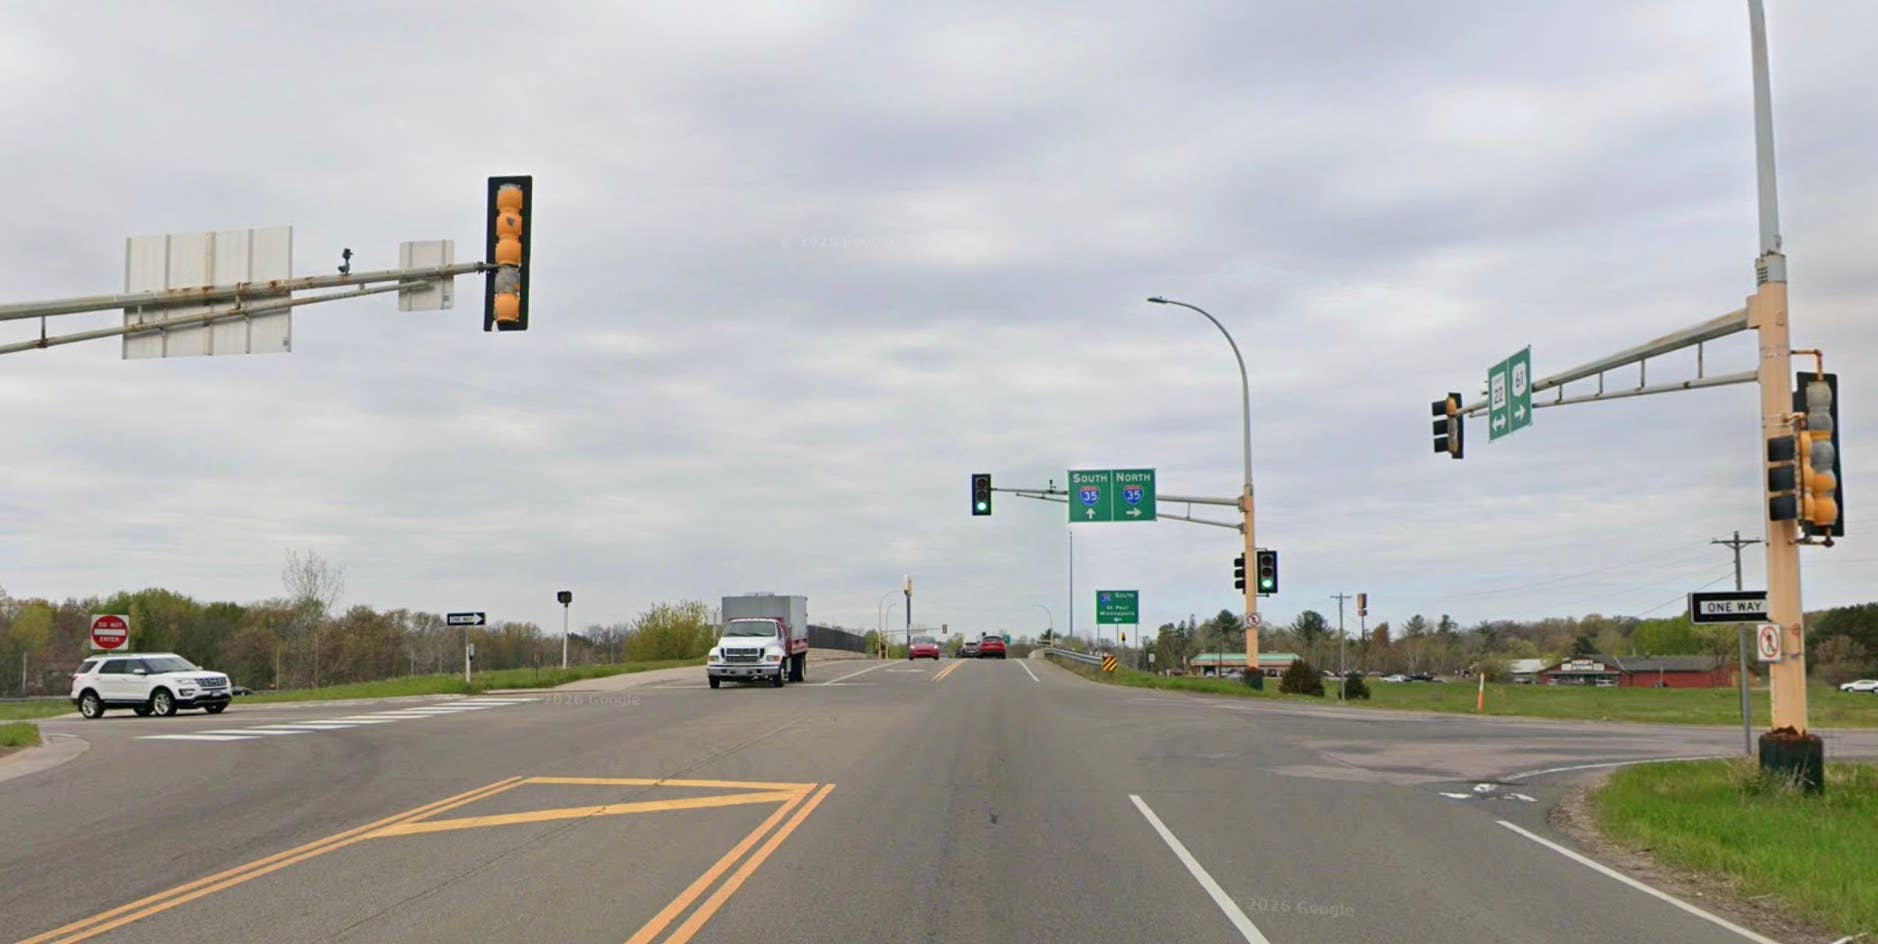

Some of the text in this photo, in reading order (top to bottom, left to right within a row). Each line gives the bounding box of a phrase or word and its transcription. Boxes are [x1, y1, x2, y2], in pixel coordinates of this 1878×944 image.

[1514, 370, 1524, 388] 61
[1494, 386, 1503, 405] 22
[1073, 473, 1108, 483] SOUTH
[1116, 473, 1151, 482] NORTH
[1083, 491, 1098, 501] 35
[1127, 490, 1141, 500] 35
[1707, 601, 1763, 613] ONE WAY
